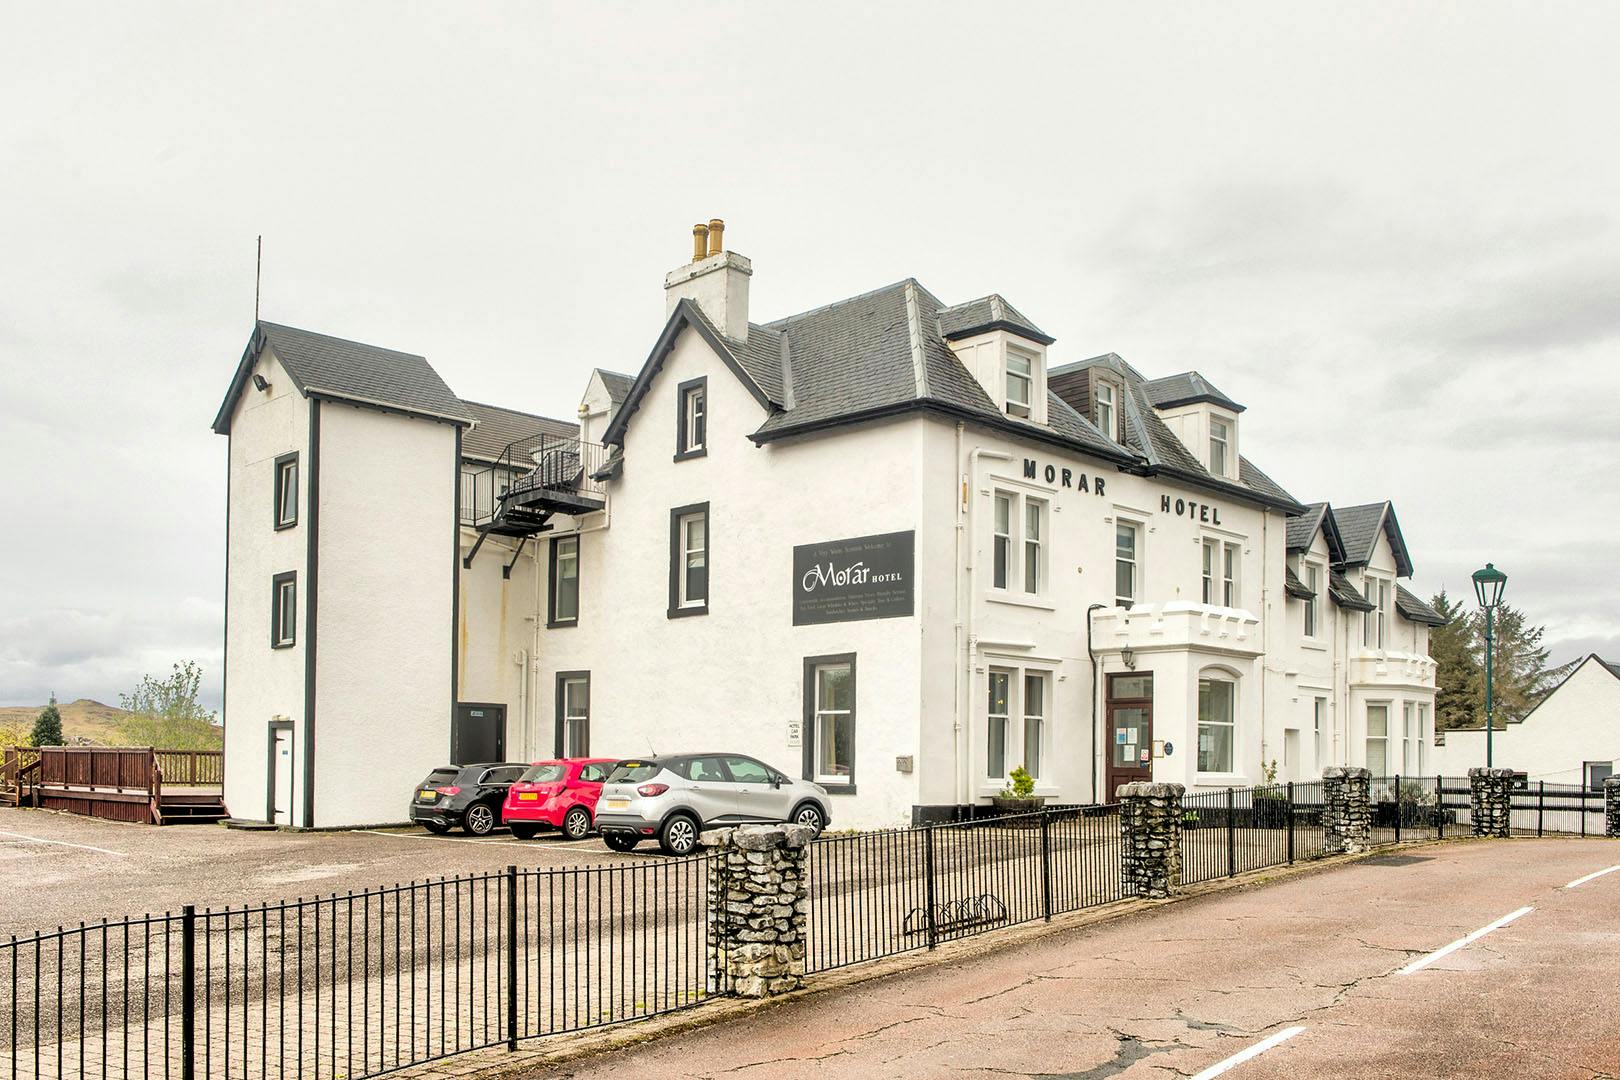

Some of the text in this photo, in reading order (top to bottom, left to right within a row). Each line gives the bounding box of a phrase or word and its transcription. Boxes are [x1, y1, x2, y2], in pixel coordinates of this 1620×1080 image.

[1024, 458, 1222, 526] MORAR HOTEL
[802, 561, 902, 592] Morar HOTEL
